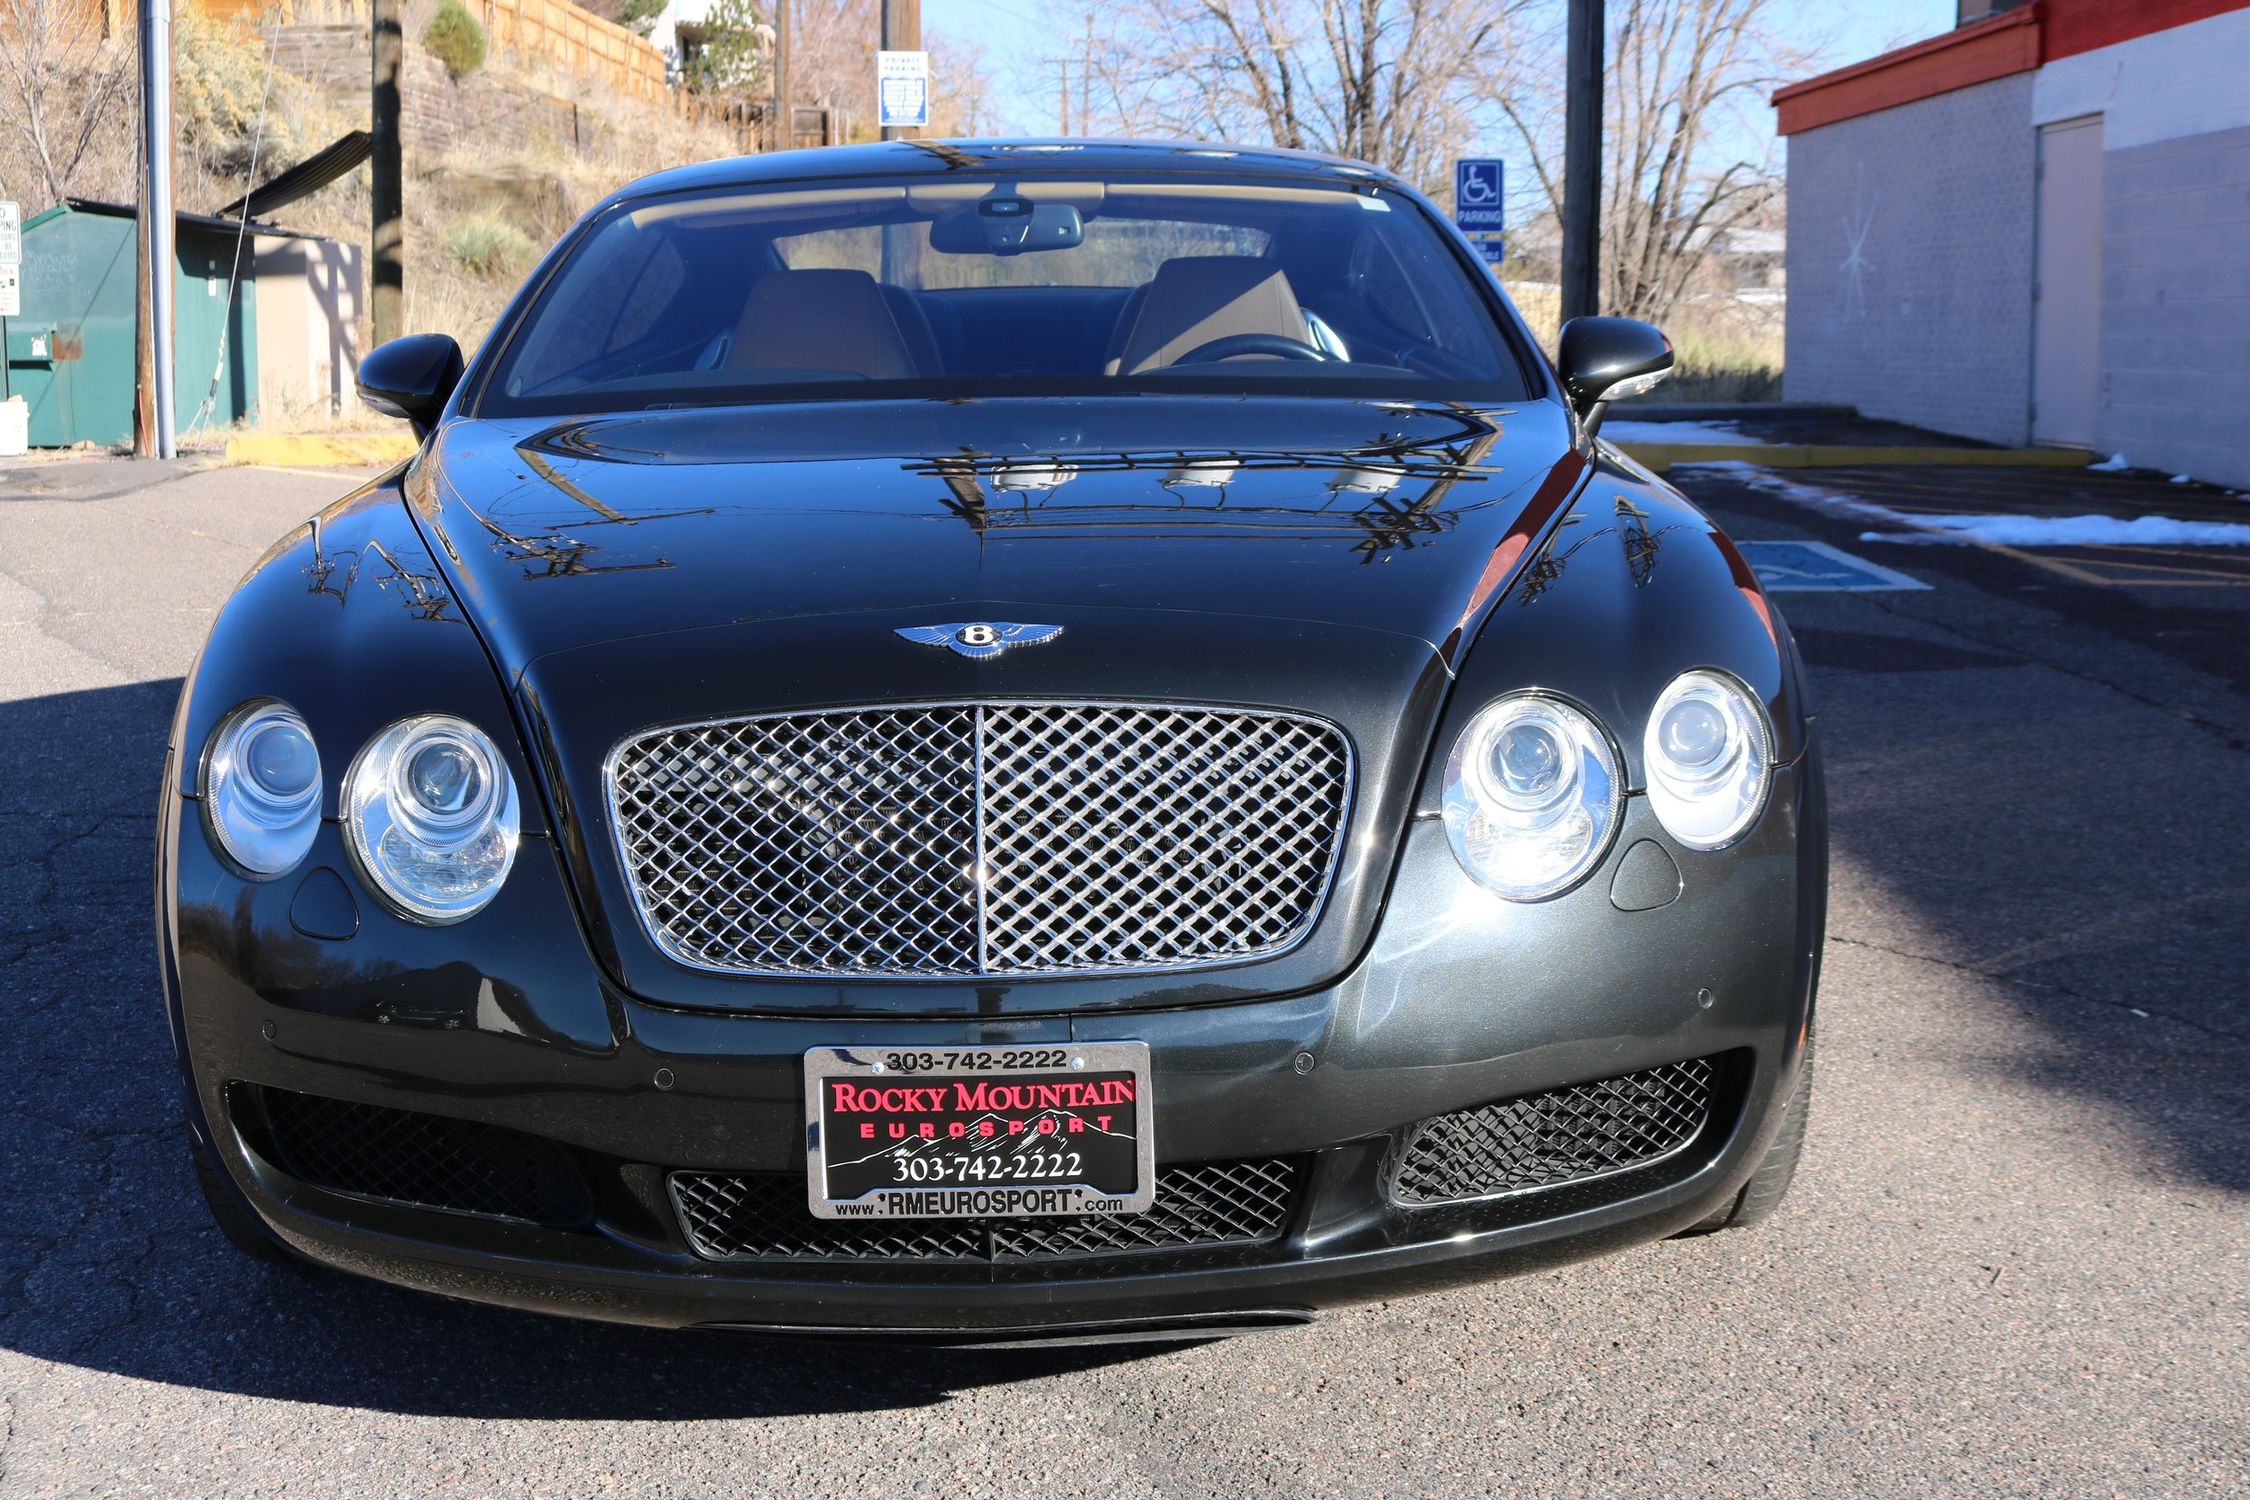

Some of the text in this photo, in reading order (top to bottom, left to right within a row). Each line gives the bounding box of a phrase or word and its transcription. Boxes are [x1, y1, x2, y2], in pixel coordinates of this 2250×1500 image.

[1458, 210, 1501, 224] PARKING
[886, 1050, 1068, 1071] 303-742-2222
[832, 1079, 1136, 1113] ROCKY MOUNTAIN
[860, 1116, 1112, 1139] EUROSPORT
[892, 1152, 1084, 1182] 303-742-2222
